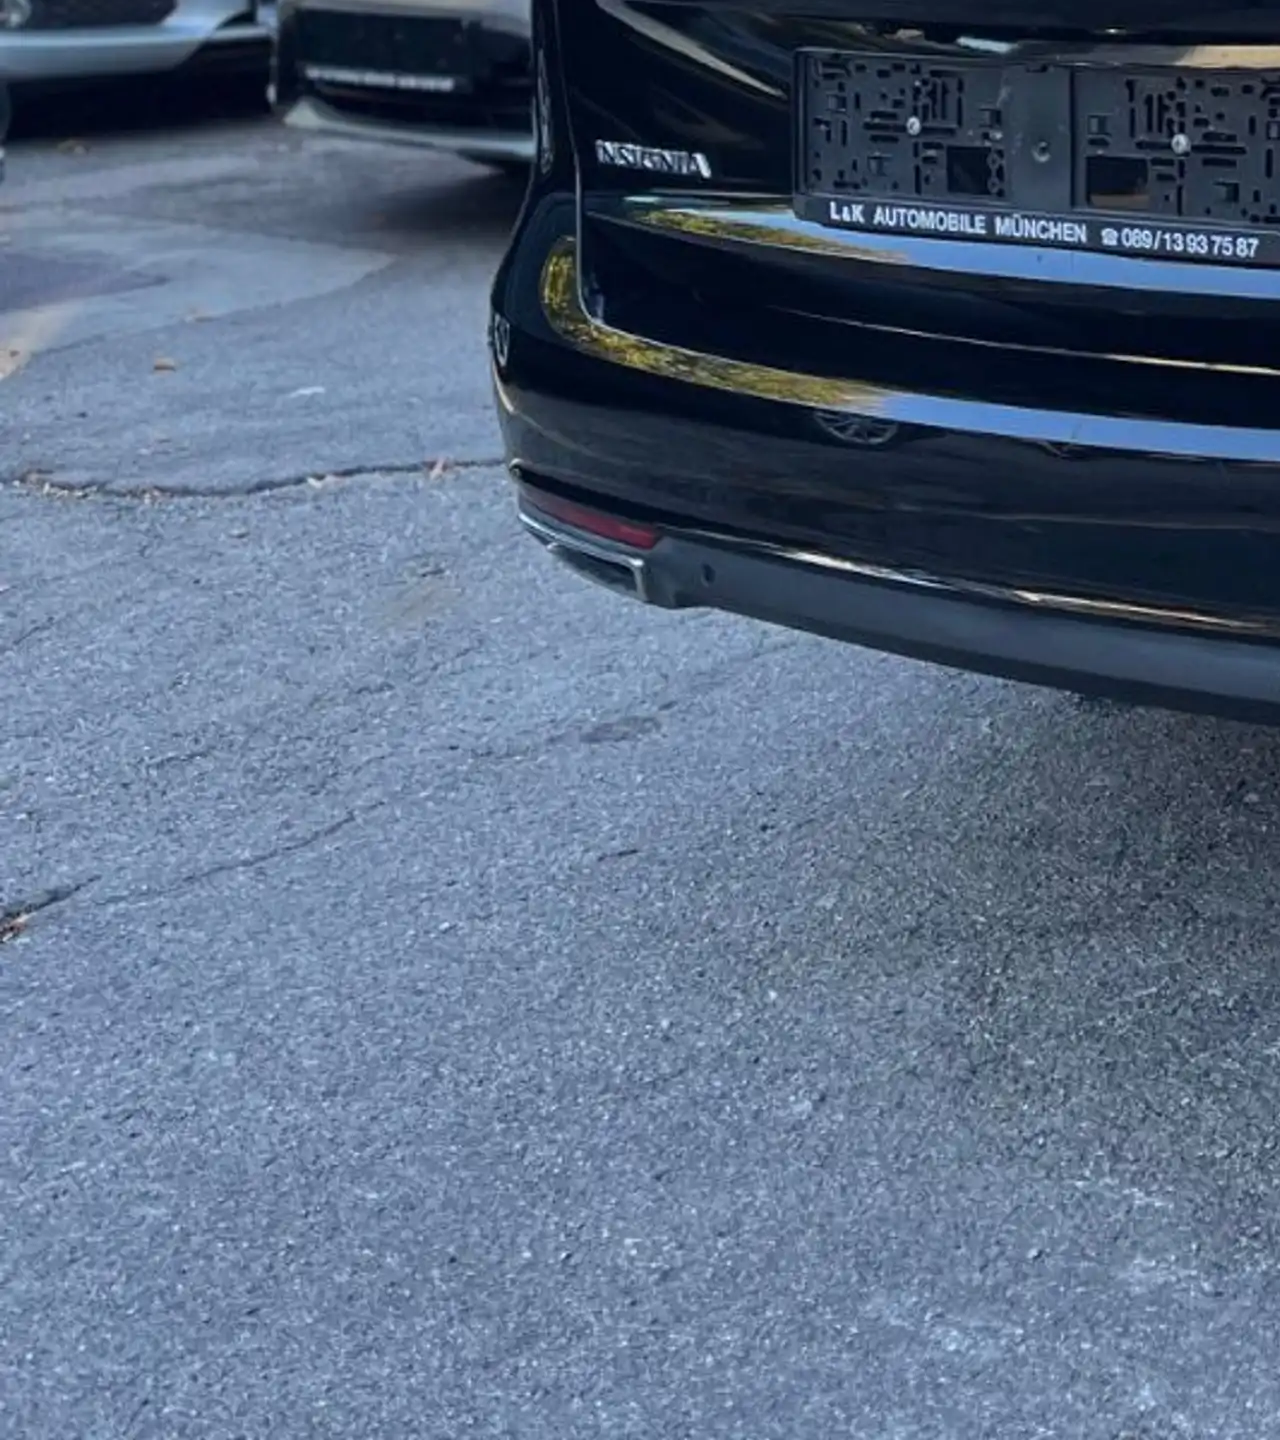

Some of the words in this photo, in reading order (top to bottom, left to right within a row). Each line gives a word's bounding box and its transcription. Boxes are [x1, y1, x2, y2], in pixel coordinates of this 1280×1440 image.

[595, 139, 711, 178] INSIGNIA
[829, 201, 865, 223] L&K
[872, 206, 987, 235] AUTOMOBILE
[995, 214, 1087, 243] MÜNCHEN
